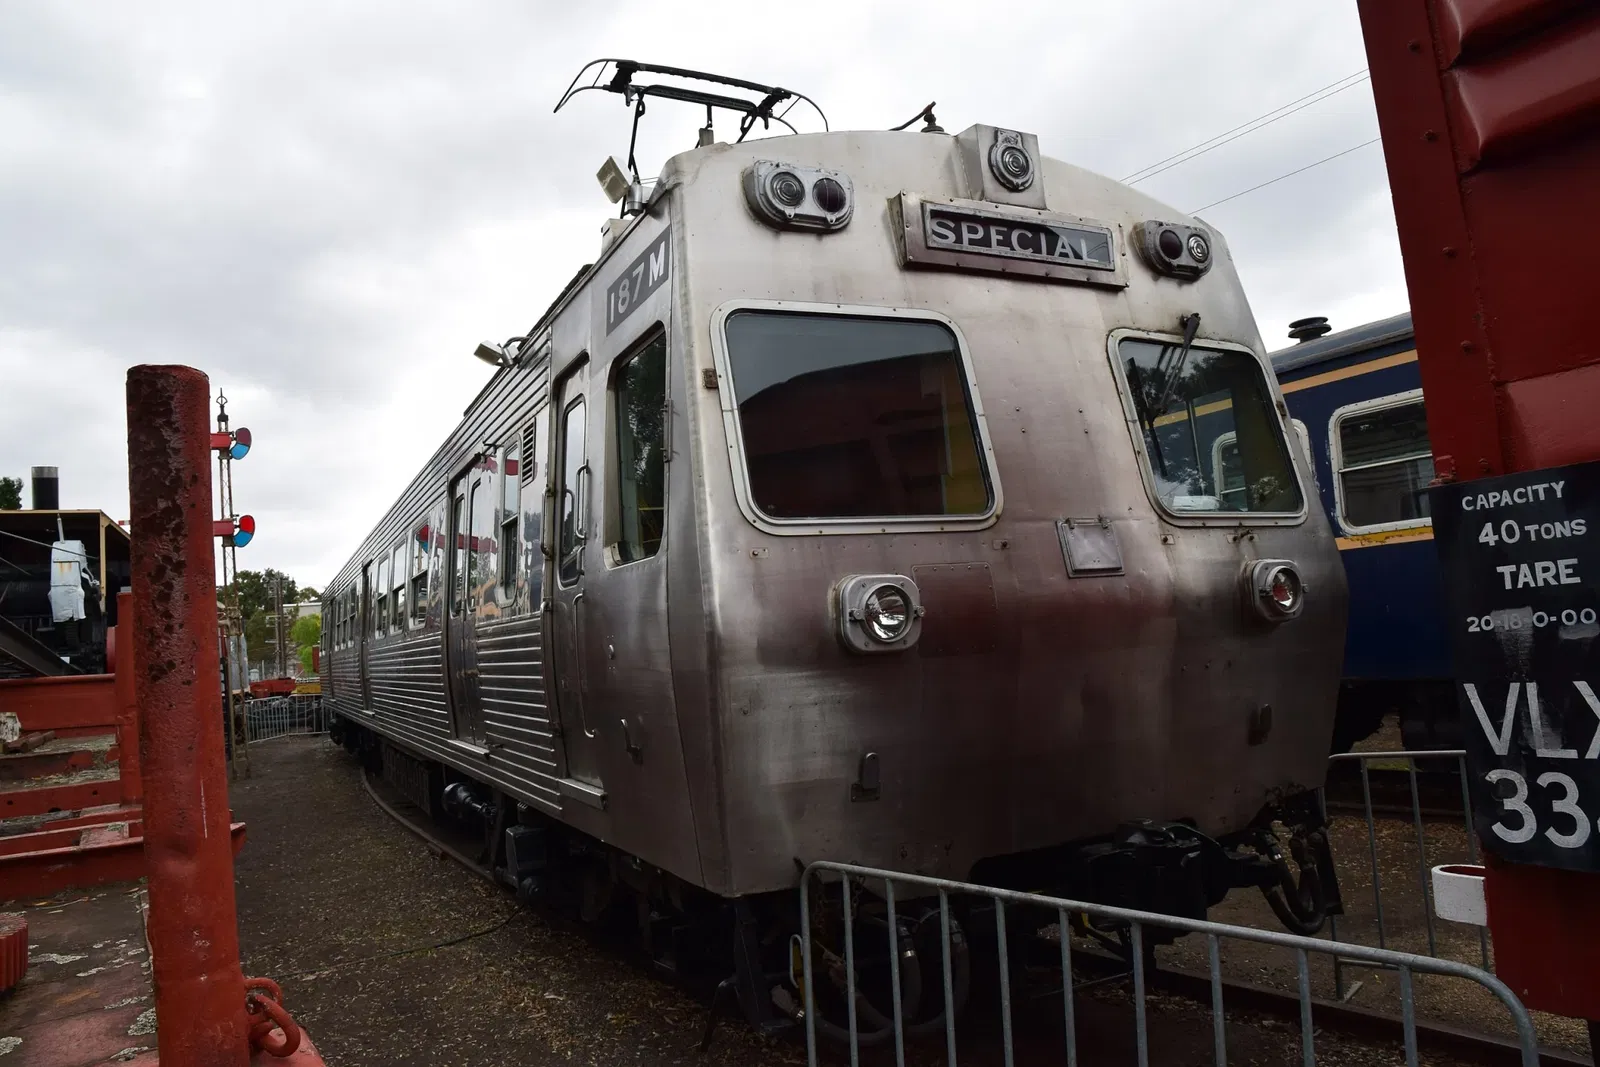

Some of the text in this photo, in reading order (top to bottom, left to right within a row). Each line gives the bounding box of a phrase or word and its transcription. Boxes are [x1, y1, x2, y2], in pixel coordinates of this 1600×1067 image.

[930, 217, 1099, 263] SPECIAL
[610, 241, 666, 324] 187 M
[1461, 481, 1565, 511] CAPACITY
[1478, 518, 1587, 546] 40 TONS
[1496, 558, 1582, 590] TARE
[1485, 768, 1600, 849] 33
